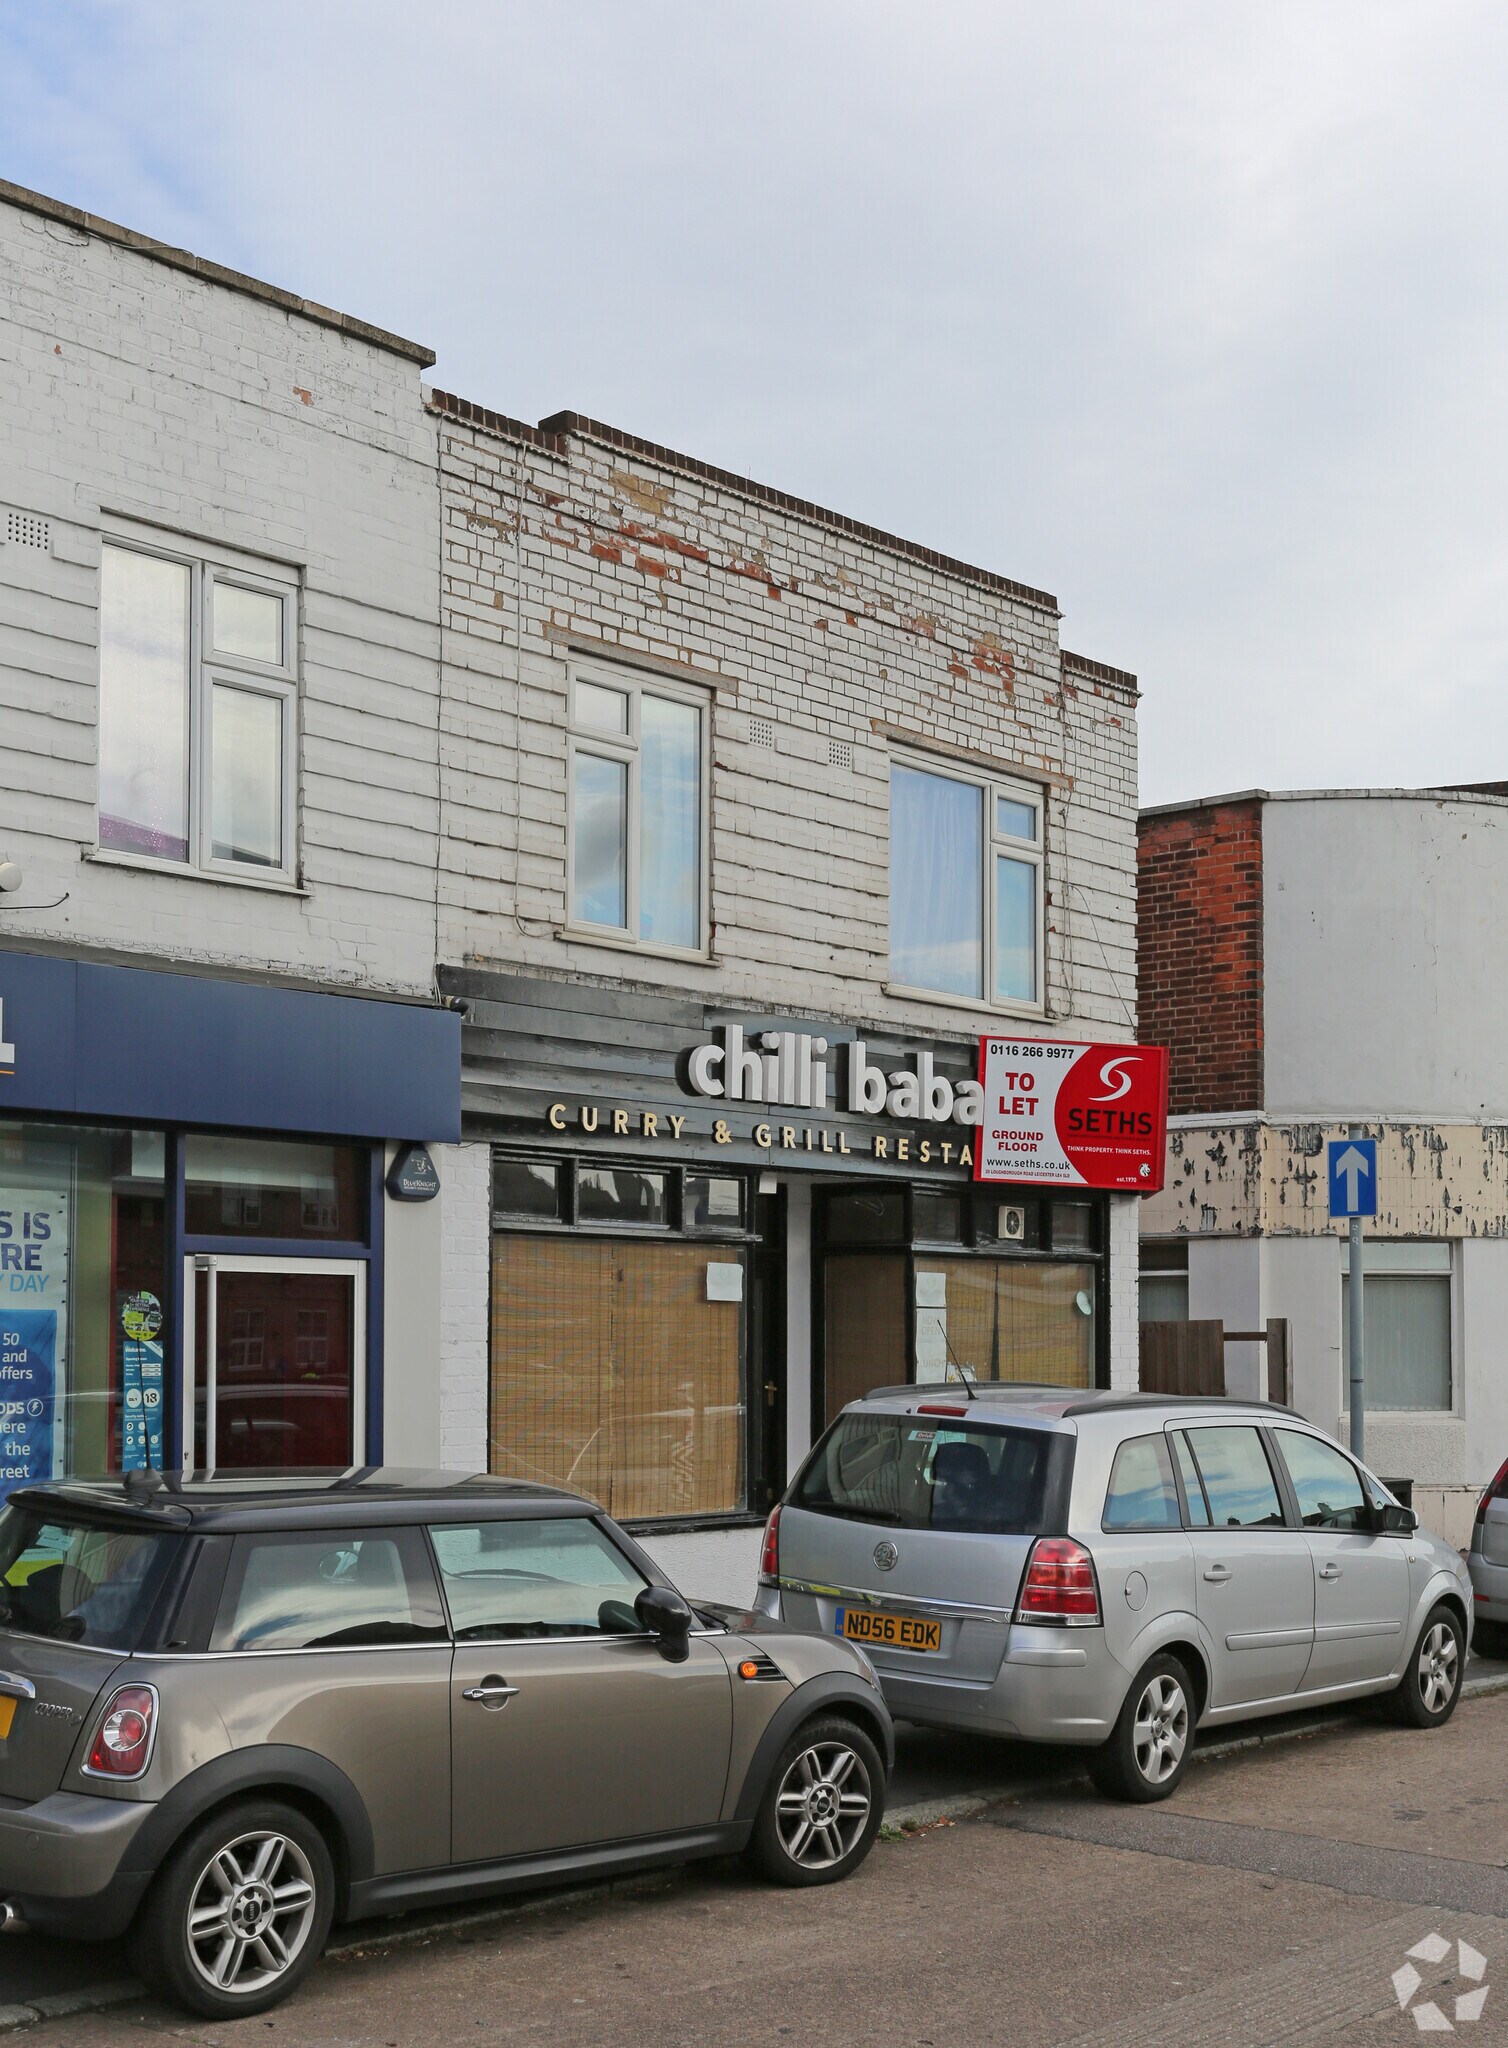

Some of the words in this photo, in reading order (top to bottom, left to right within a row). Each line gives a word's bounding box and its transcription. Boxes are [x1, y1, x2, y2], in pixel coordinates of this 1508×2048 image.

[991, 1044, 1019, 1056] 0116
[1022, 1046, 1043, 1058] 266
[1046, 1048, 1075, 1059] 9977
[688, 1024, 828, 1108] chilli
[848, 1041, 985, 1126] baba
[1005, 1072, 1035, 1092] TO
[999, 1096, 1039, 1116] LET
[1068, 1108, 1152, 1135] SETHS
[549, 1103, 685, 1139] CURRY
[713, 1119, 733, 1144] &
[754, 1123, 851, 1154] GRILL
[874, 1135, 974, 1166] RESTA
[992, 1129, 1044, 1141] GROUND
[998, 1142, 1037, 1152] FLOOR
[1084, 1146, 1115, 1154] PROPERTY.
[986, 1159, 1071, 1170] www.seths.co.uk
[24, 1212, 51, 1240] IS
[1, 1243, 42, 1272] RE
[10, 1273, 50, 1293] DAY
[2, 1332, 20, 1346] 50
[2, 1349, 28, 1363] and
[0, 1366, 33, 1380] ffers
[0, 1421, 26, 1434] ere
[5, 1441, 31, 1456] the
[0, 1464, 30, 1479] reet
[847, 1613, 896, 1640] ND56
[900, 1620, 938, 1647] EDK
